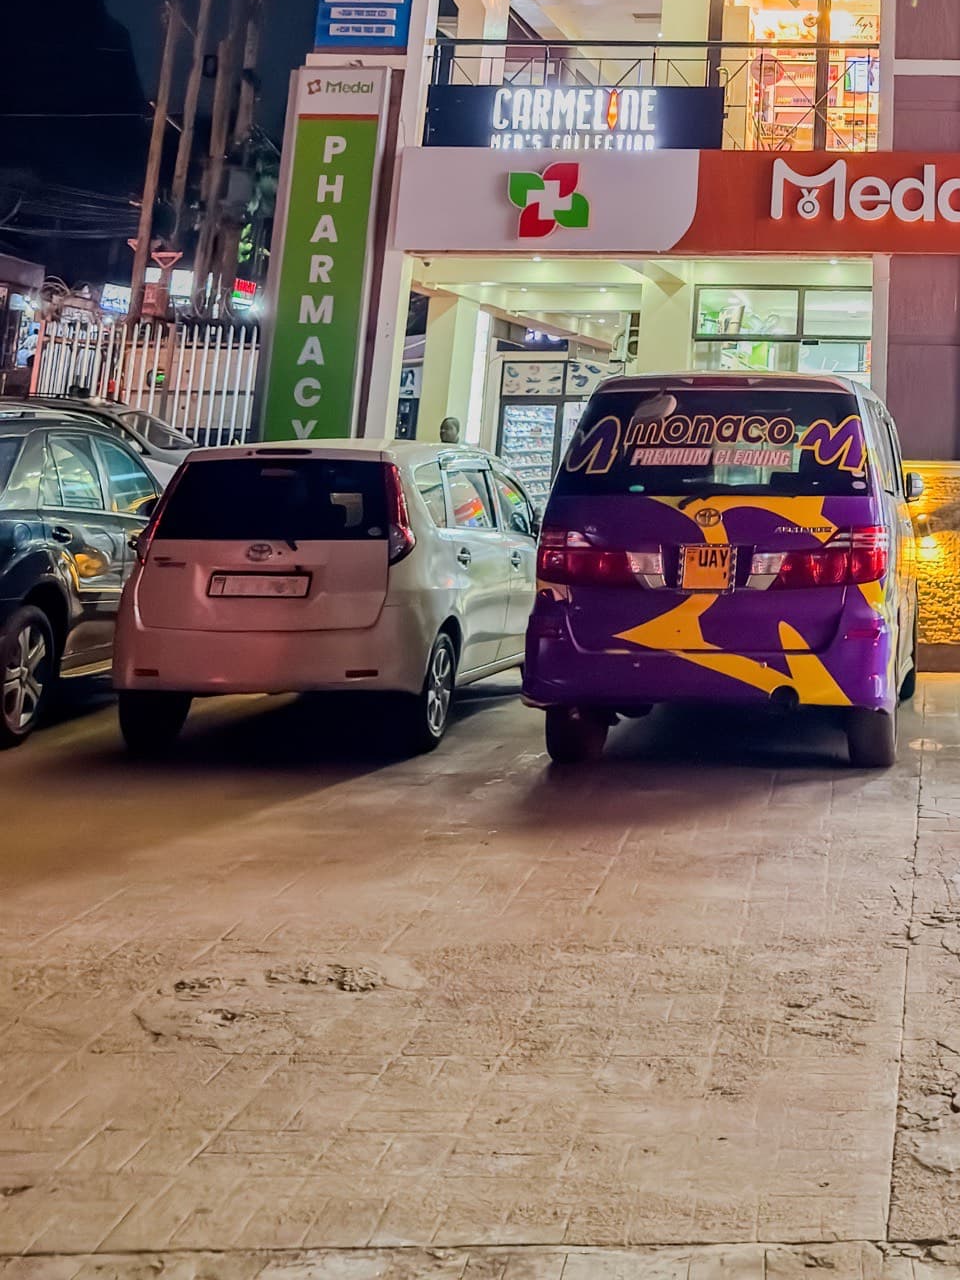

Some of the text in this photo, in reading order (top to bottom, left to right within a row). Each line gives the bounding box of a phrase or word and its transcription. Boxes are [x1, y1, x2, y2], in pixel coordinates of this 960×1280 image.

[324, 79, 375, 95] Medal
[623, 415, 796, 447] monaco
[630, 447, 792, 467] PREMIUM CLEANING
[699, 549, 729, 568] UAY
